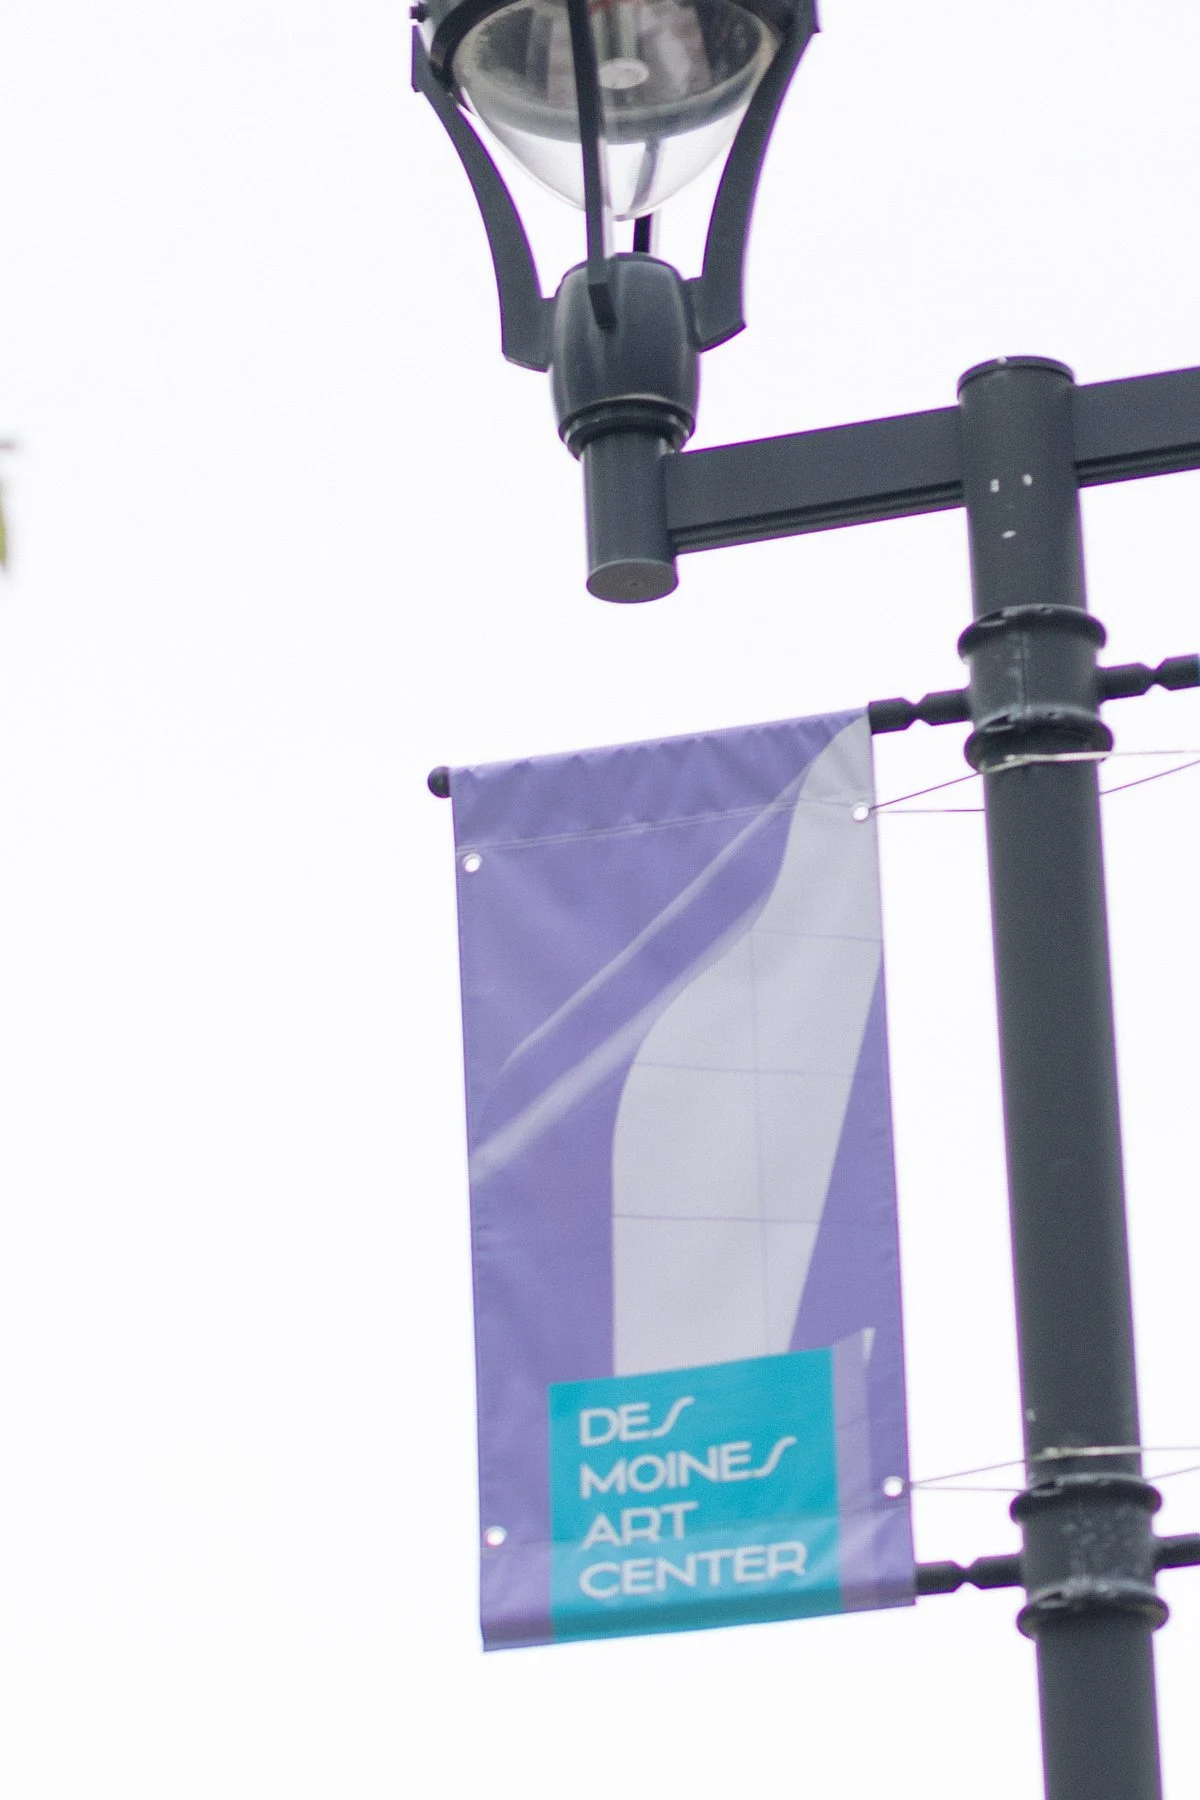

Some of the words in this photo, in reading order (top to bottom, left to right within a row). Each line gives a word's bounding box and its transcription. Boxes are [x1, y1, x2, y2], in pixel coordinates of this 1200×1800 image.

[579, 1396, 696, 1448] DES
[579, 1436, 798, 1499] MOINES
[581, 1501, 699, 1550] ART
[579, 1541, 807, 1600] CENTER
